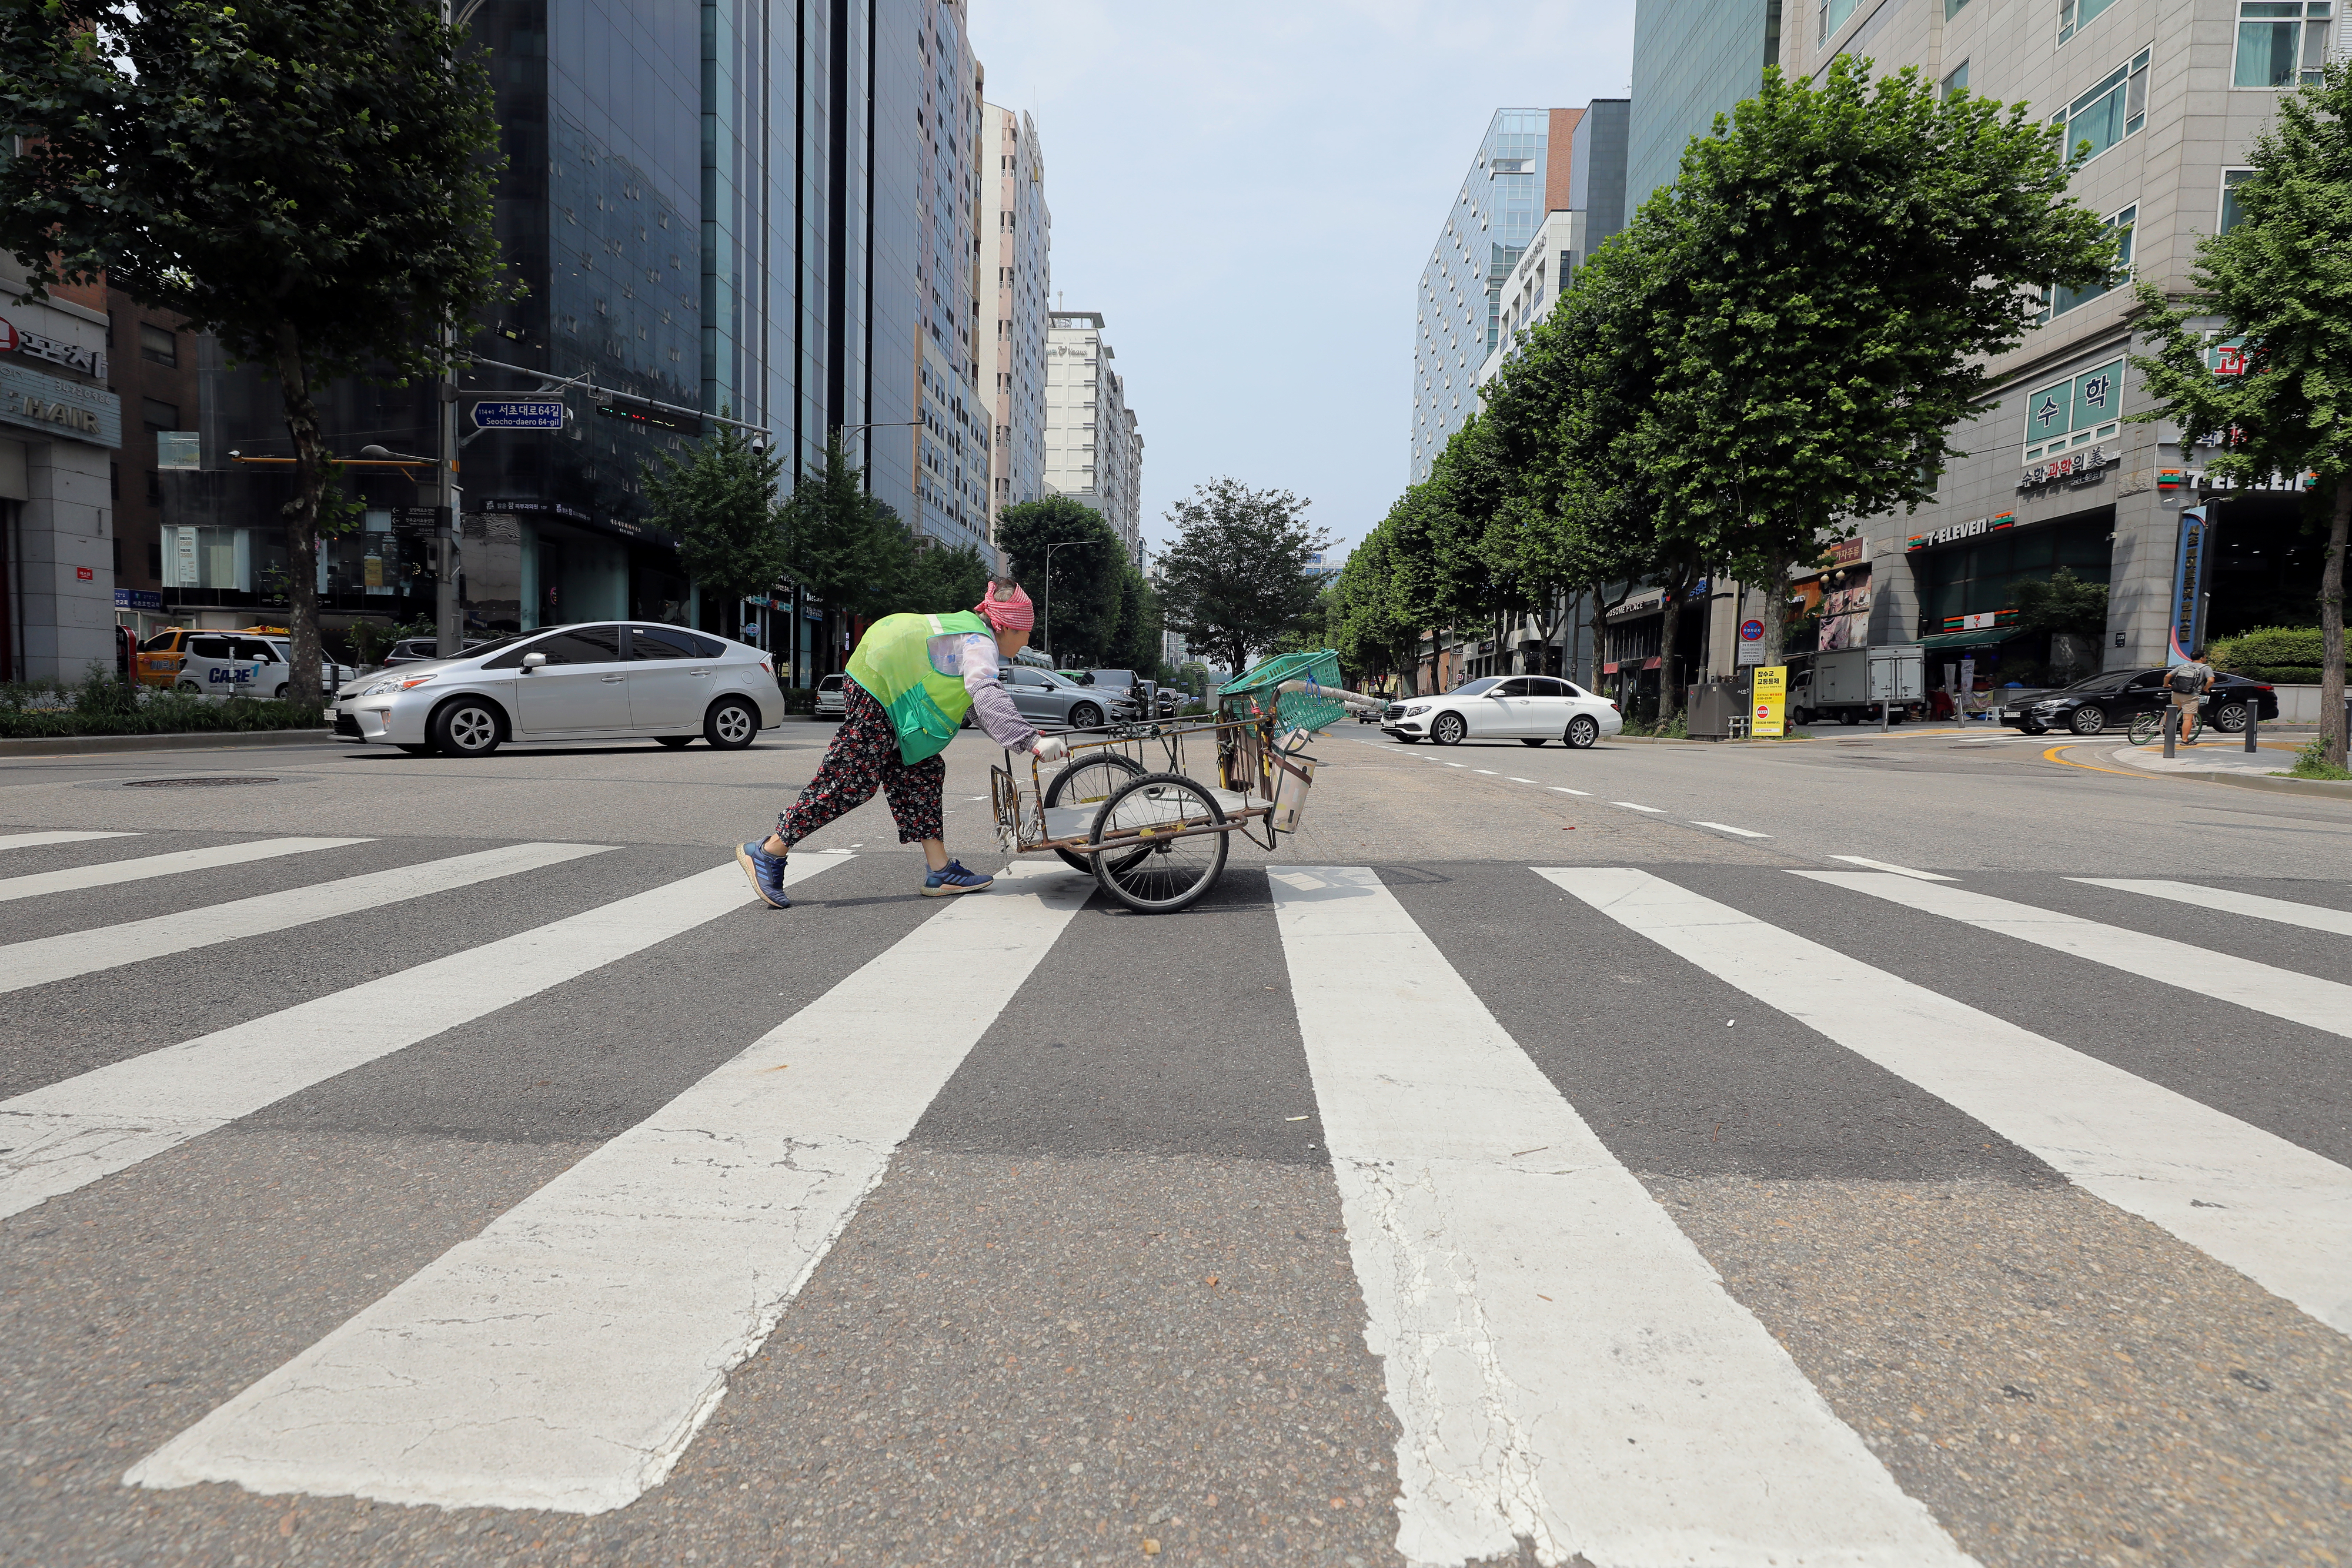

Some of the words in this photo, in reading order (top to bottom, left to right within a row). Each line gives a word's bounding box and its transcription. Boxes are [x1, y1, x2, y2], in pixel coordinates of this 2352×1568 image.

[20, 330, 108, 378] 포차
[56, 381, 111, 404] 34720986
[24, 397, 101, 433] HAIR
[499, 405, 559, 417] 서초대로64길
[539, 419, 559, 427] 64-gil
[2072, 471, 2101, 484] 521-6839
[507, 502, 514, 510] 참
[1626, 601, 1644, 613] PLACE
